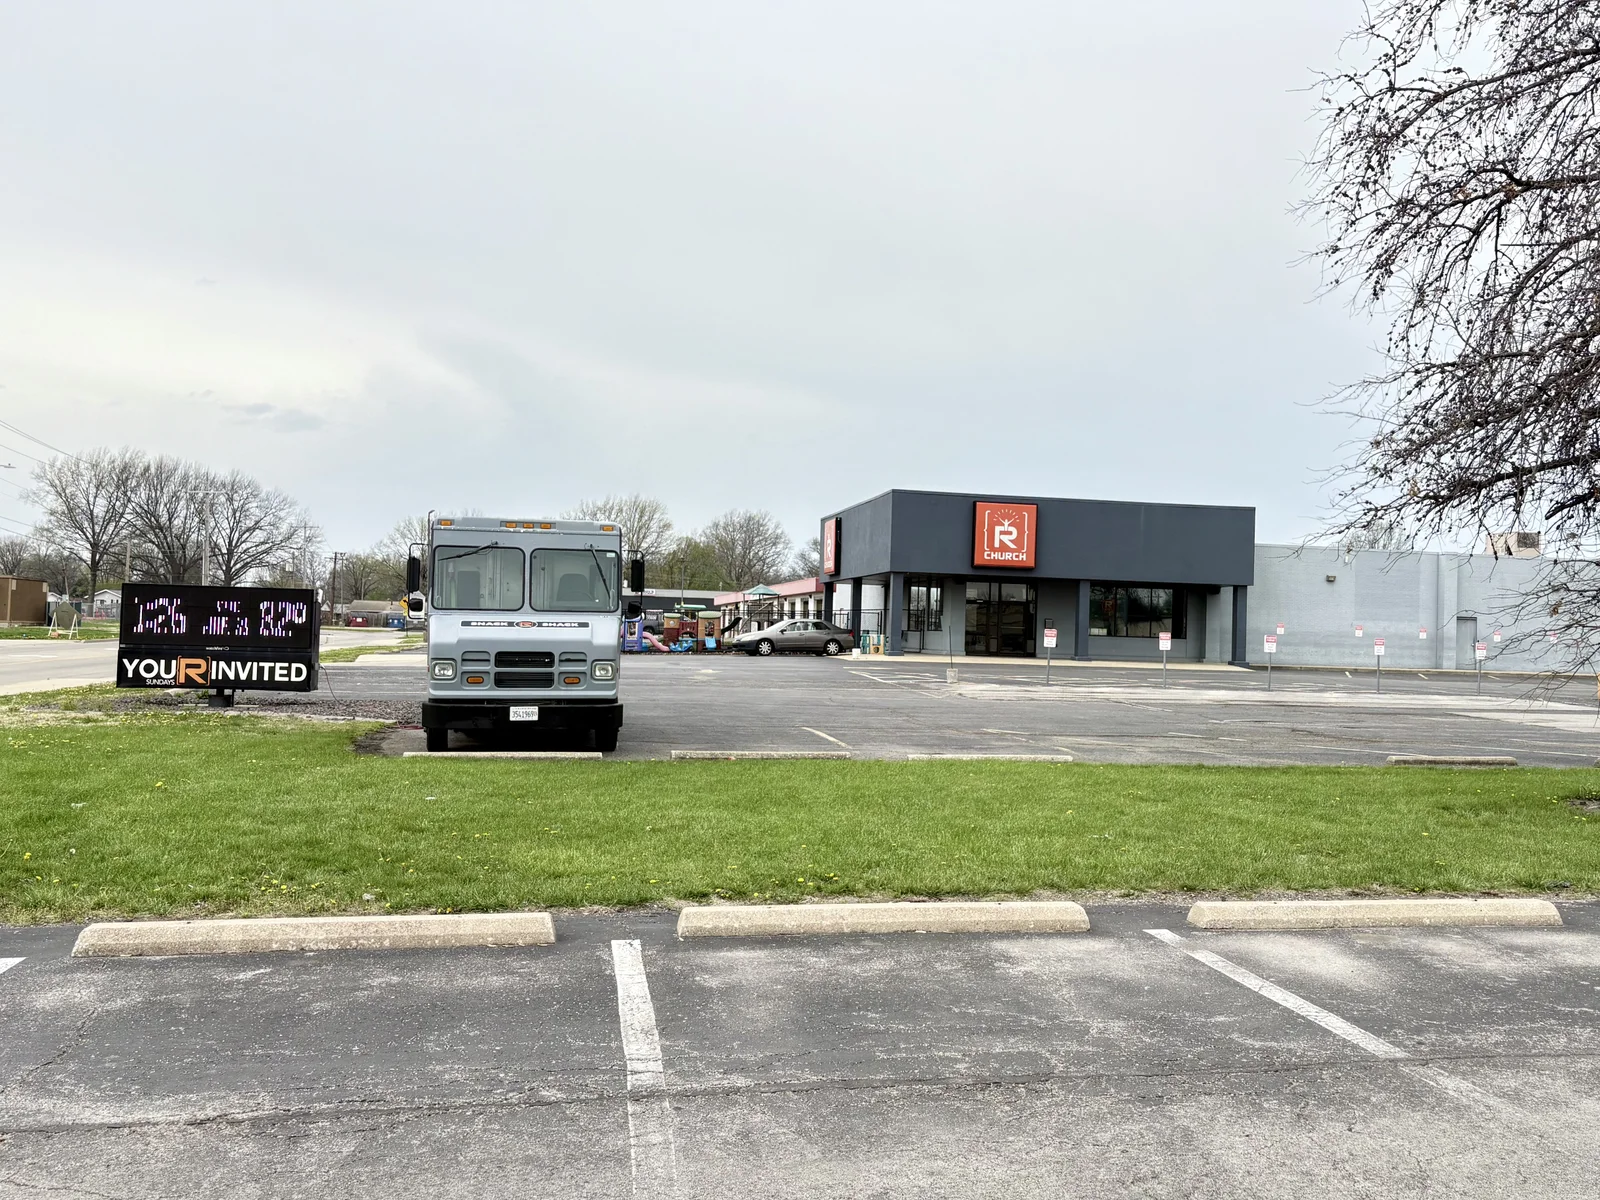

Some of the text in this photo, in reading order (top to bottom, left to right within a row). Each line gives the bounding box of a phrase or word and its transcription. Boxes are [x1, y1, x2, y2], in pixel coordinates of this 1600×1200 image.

[993, 525, 1018, 549] R
[984, 551, 1026, 561] CHURCH
[211, 661, 308, 683] INVITED
[145, 678, 176, 686] SUNDAYS
